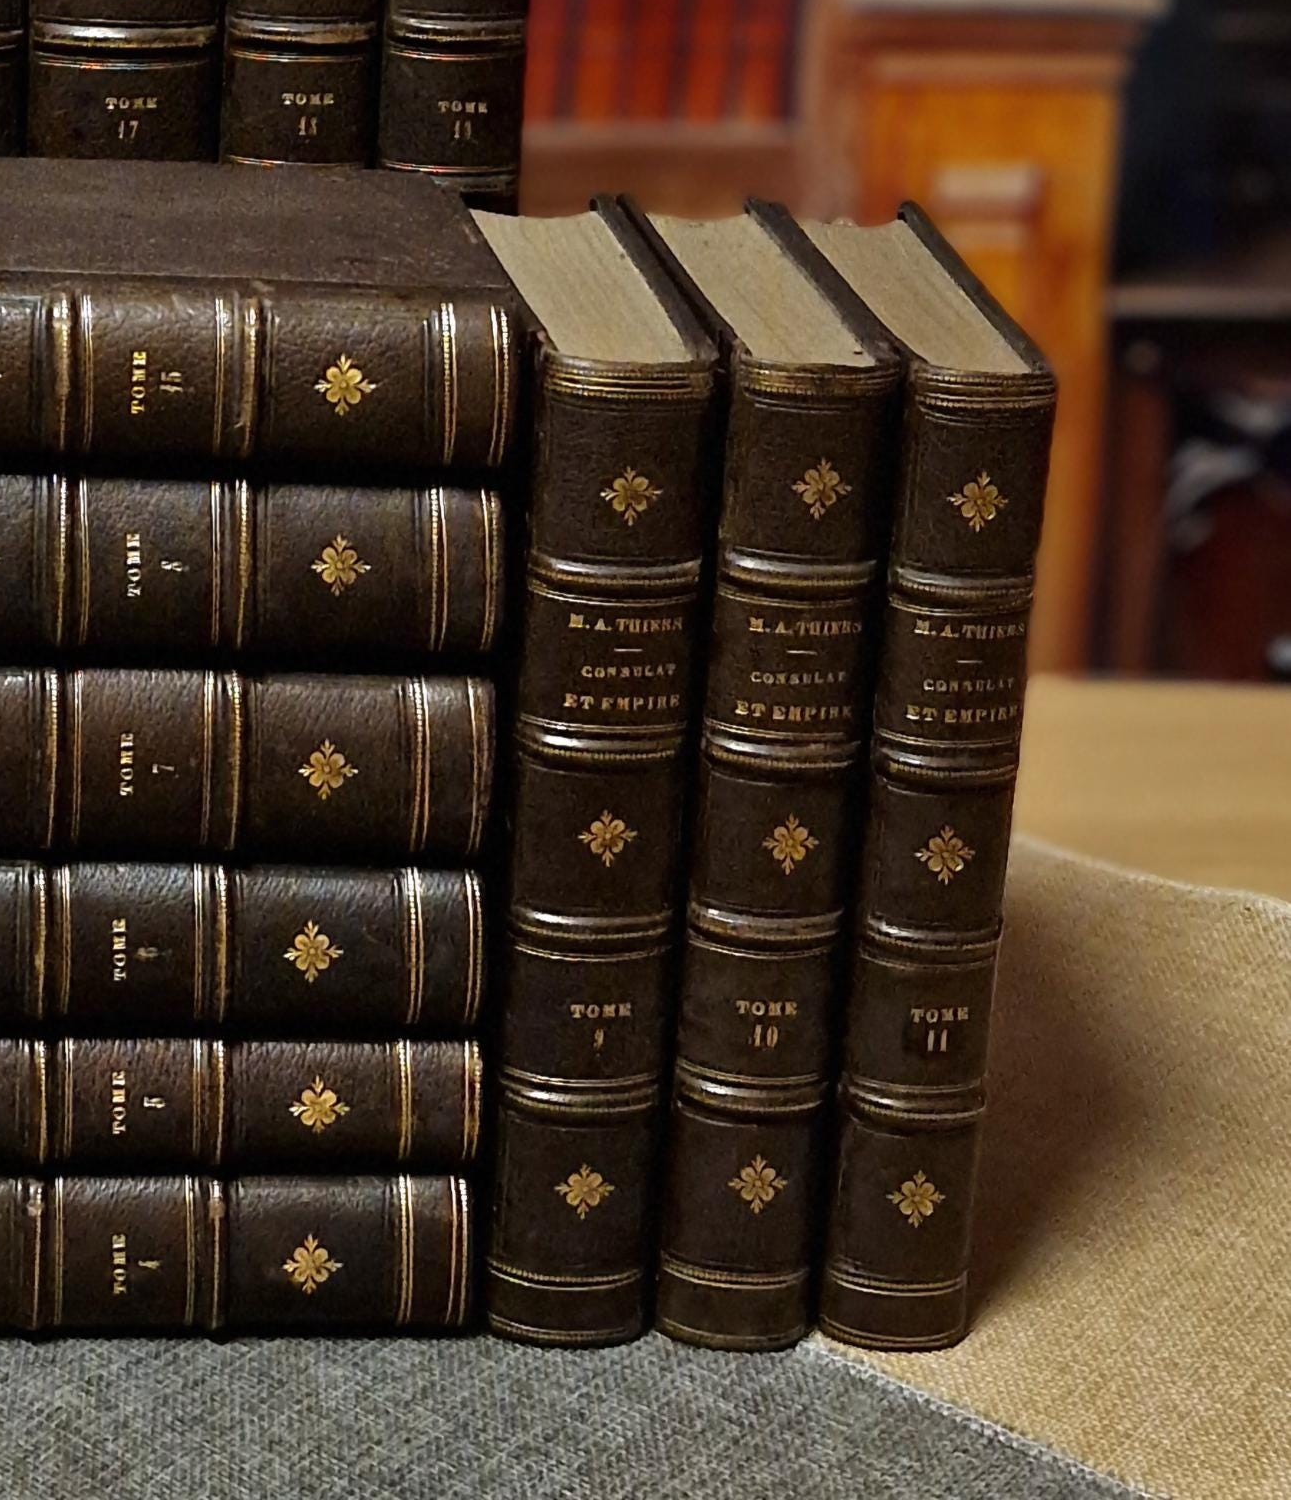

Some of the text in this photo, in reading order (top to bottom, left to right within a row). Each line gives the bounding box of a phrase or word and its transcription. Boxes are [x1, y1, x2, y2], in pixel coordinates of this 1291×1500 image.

[105, 97, 157, 110] TOME
[281, 93, 334, 105] TOME
[438, 101, 488, 114] TOME
[118, 120, 139, 140] 17
[131, 351, 146, 414] TOME
[126, 533, 141, 597] TOME
[161, 560, 182, 571] 8
[120, 733, 133, 796] TOME
[152, 763, 174, 774] 7
[112, 918, 126, 981] TOME
[570, 1003, 632, 1019] TOME
[736, 1000, 799, 1017] TOME
[911, 1006, 969, 1023] TOME
[926, 1028, 948, 1053] 11
[112, 1071, 125, 1134] TOME
[143, 1097, 165, 1108] 5
[112, 1234, 126, 1295] TOME
